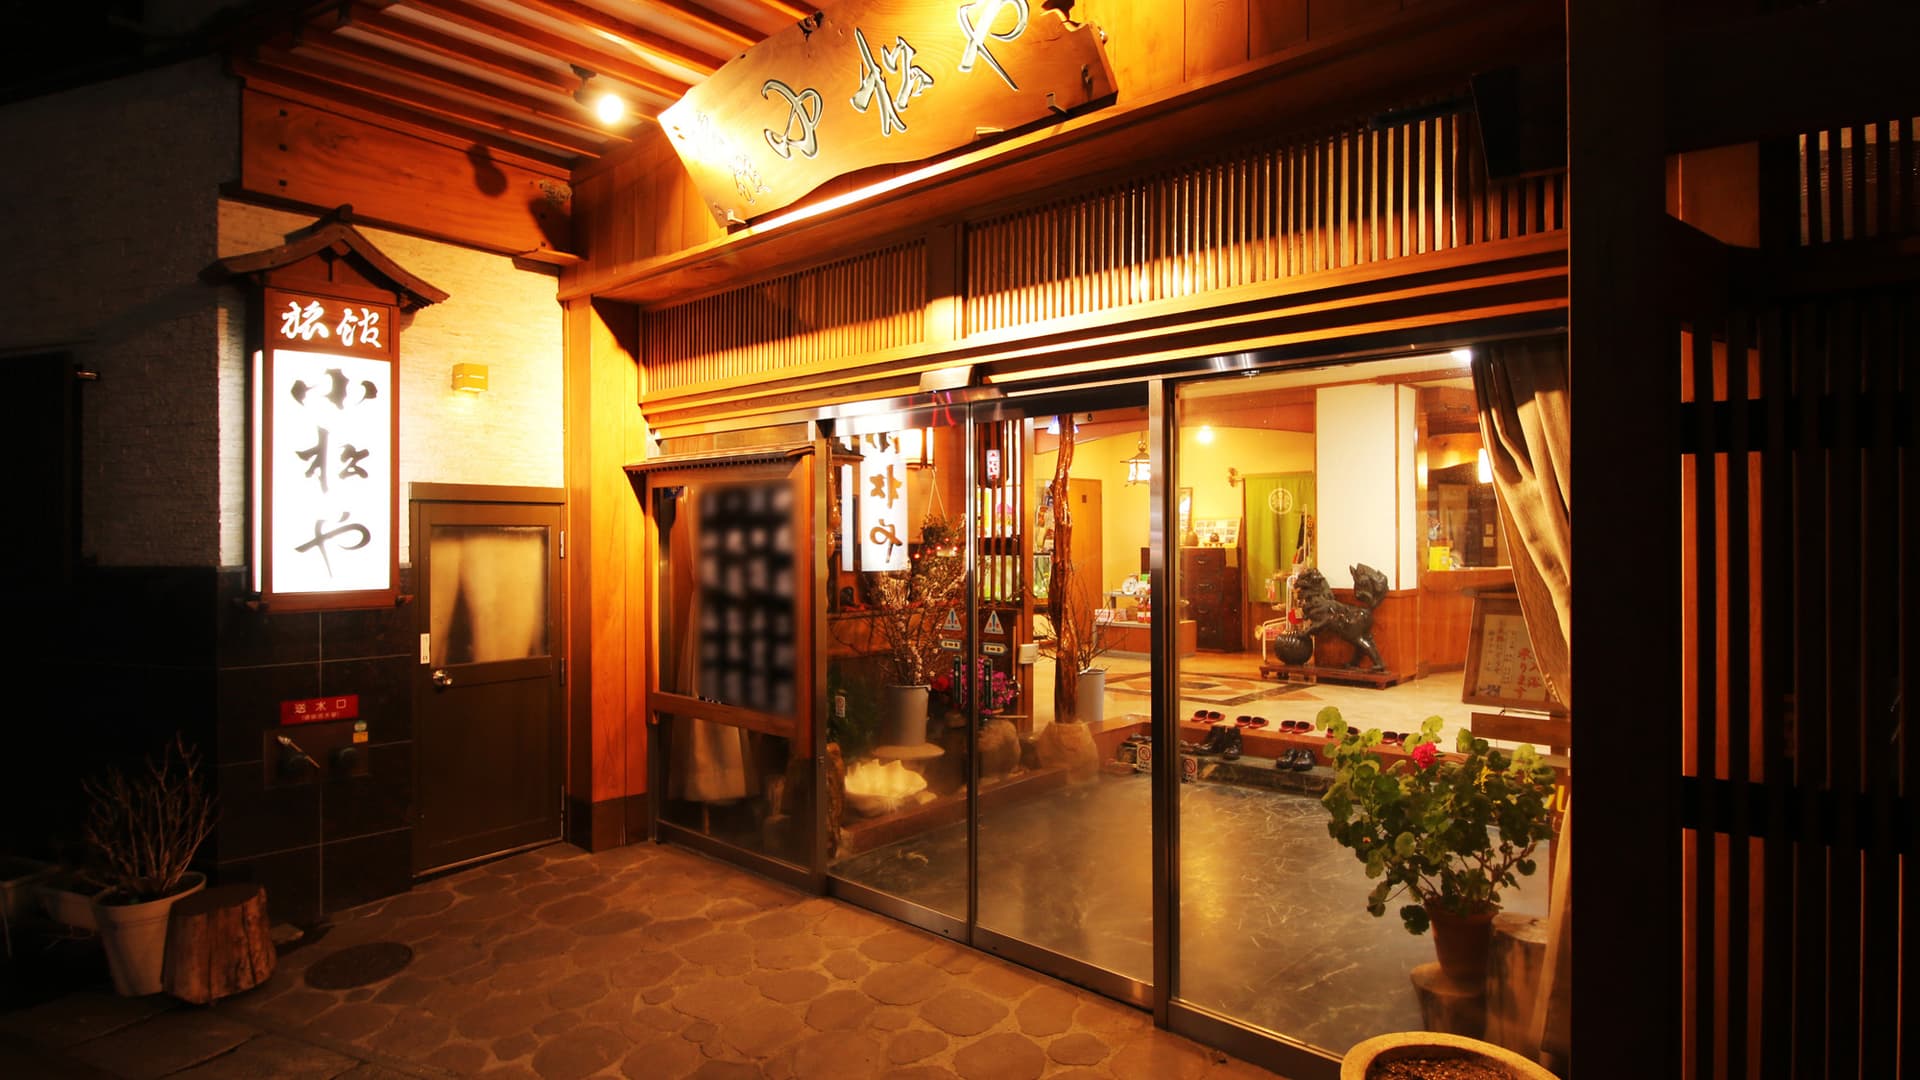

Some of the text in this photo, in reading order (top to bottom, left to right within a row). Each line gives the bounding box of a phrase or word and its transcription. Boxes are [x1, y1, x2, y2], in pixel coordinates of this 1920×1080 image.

[280, 300, 381, 348] 旅館
[290, 367, 379, 578] 小松や
[294, 698, 347, 714] 送水口
